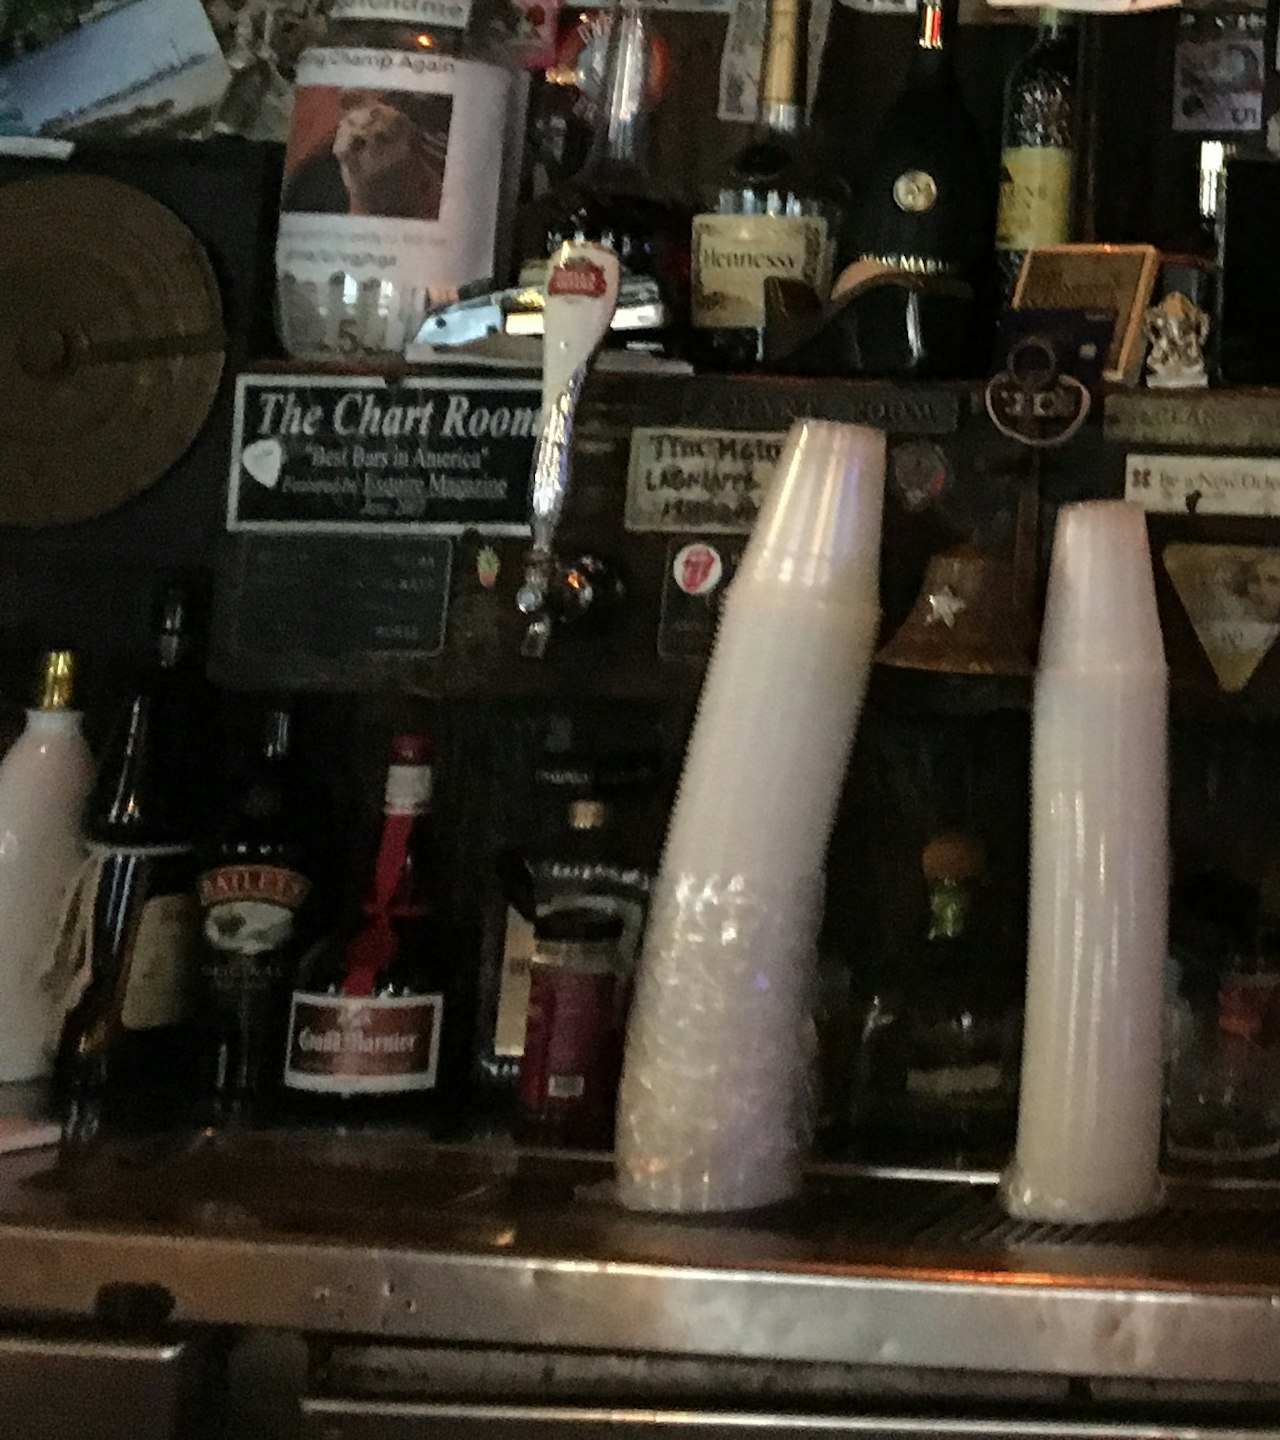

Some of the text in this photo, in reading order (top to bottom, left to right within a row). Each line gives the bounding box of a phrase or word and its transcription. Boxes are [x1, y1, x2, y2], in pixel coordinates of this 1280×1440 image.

[258, 391, 542, 437] The Chart Room
